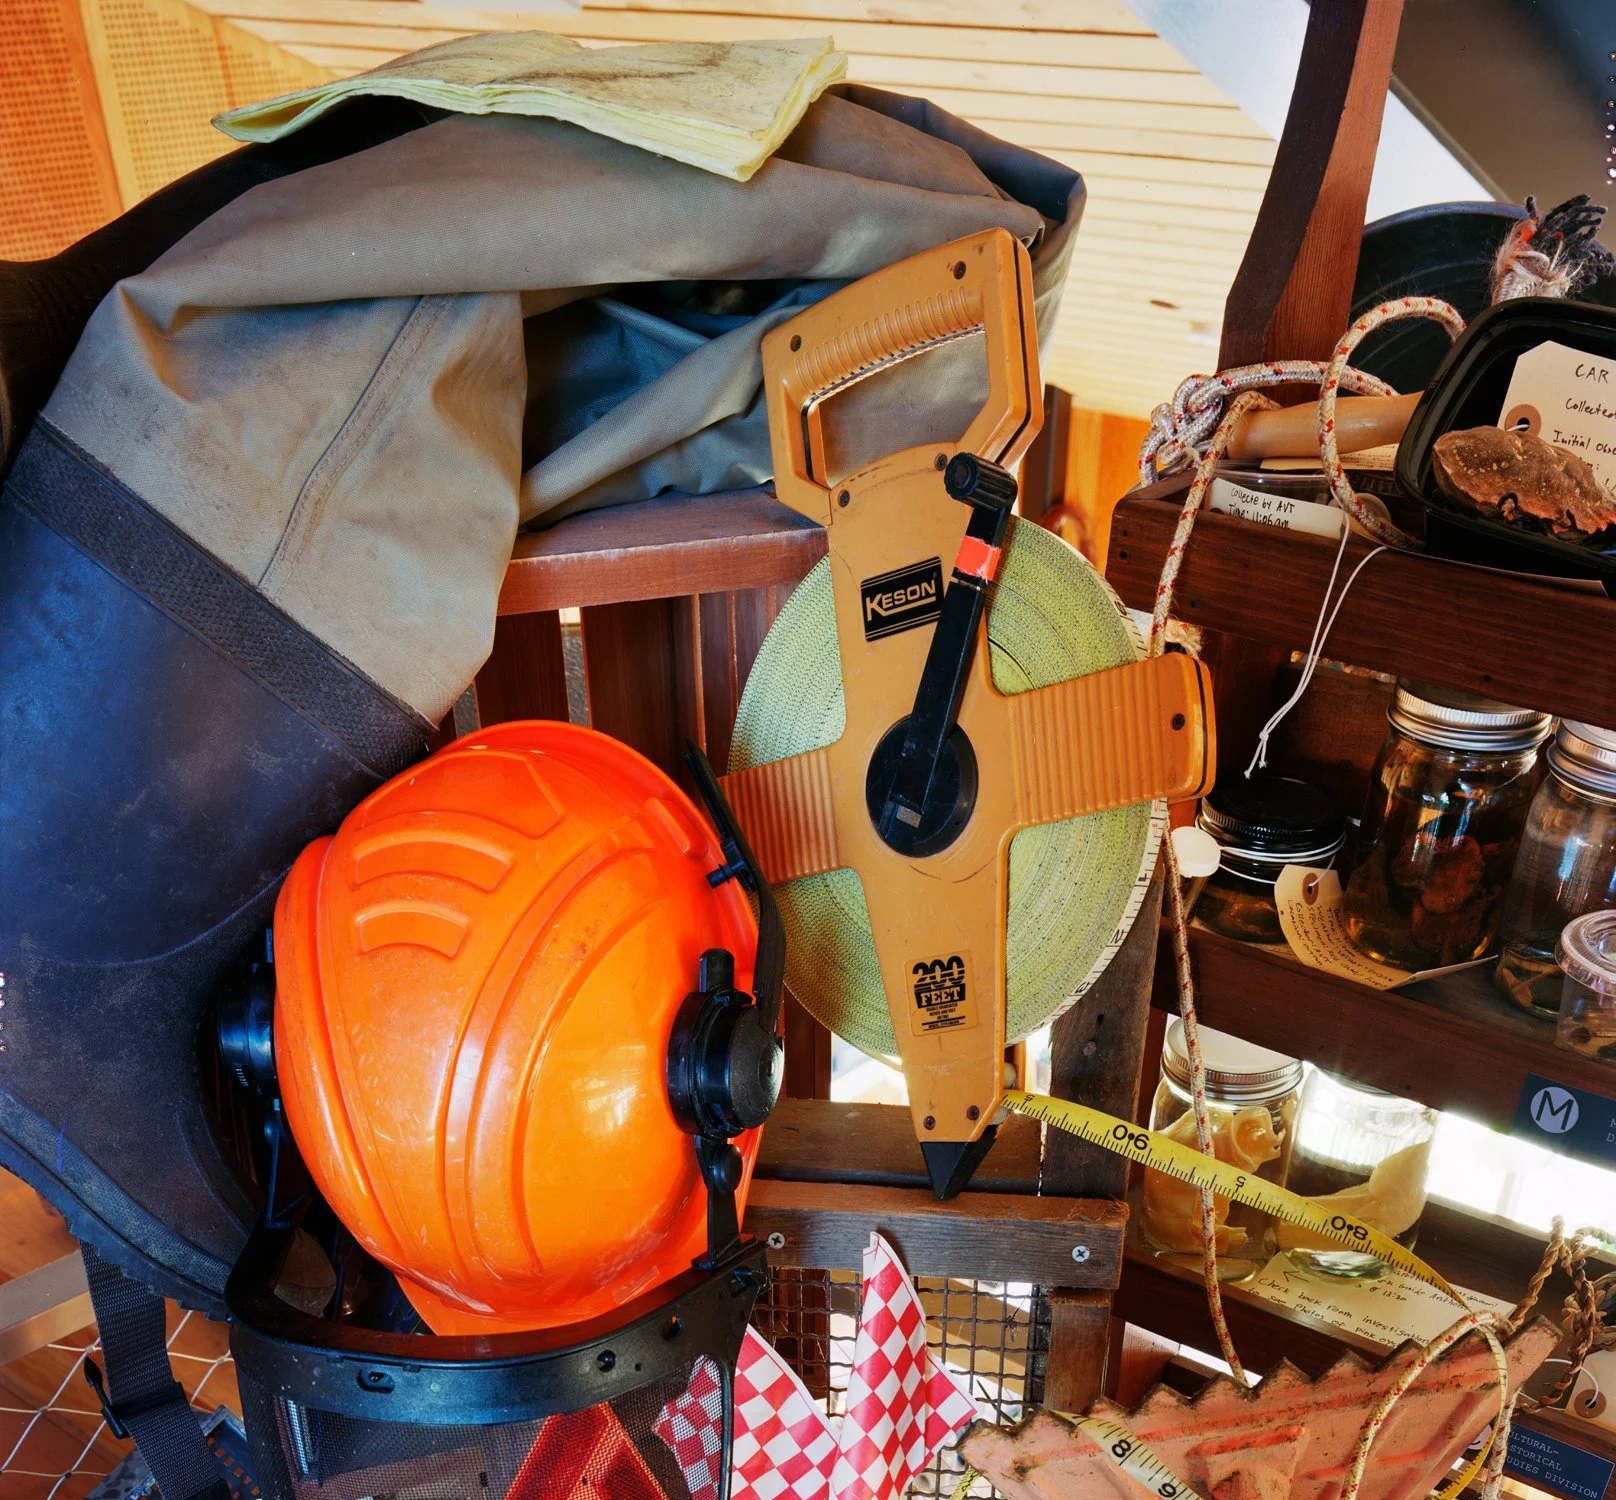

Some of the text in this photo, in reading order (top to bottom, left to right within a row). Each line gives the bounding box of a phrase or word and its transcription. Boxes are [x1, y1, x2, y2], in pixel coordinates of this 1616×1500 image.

[1552, 430, 1591, 450] Initial
[1275, 501, 1296, 515] AVT
[865, 579, 937, 622] KESON
[912, 955, 966, 991] 200
[920, 987, 961, 1006] FEET
[1535, 1089, 1575, 1131] M
[1258, 1277, 1290, 1295] Check
[1297, 1291, 1322, 1309] back
[1326, 1302, 1353, 1320] room
[1507, 1430, 1560, 1456] ULTURAL-
[1544, 1471, 1599, 1500] DIVISION
